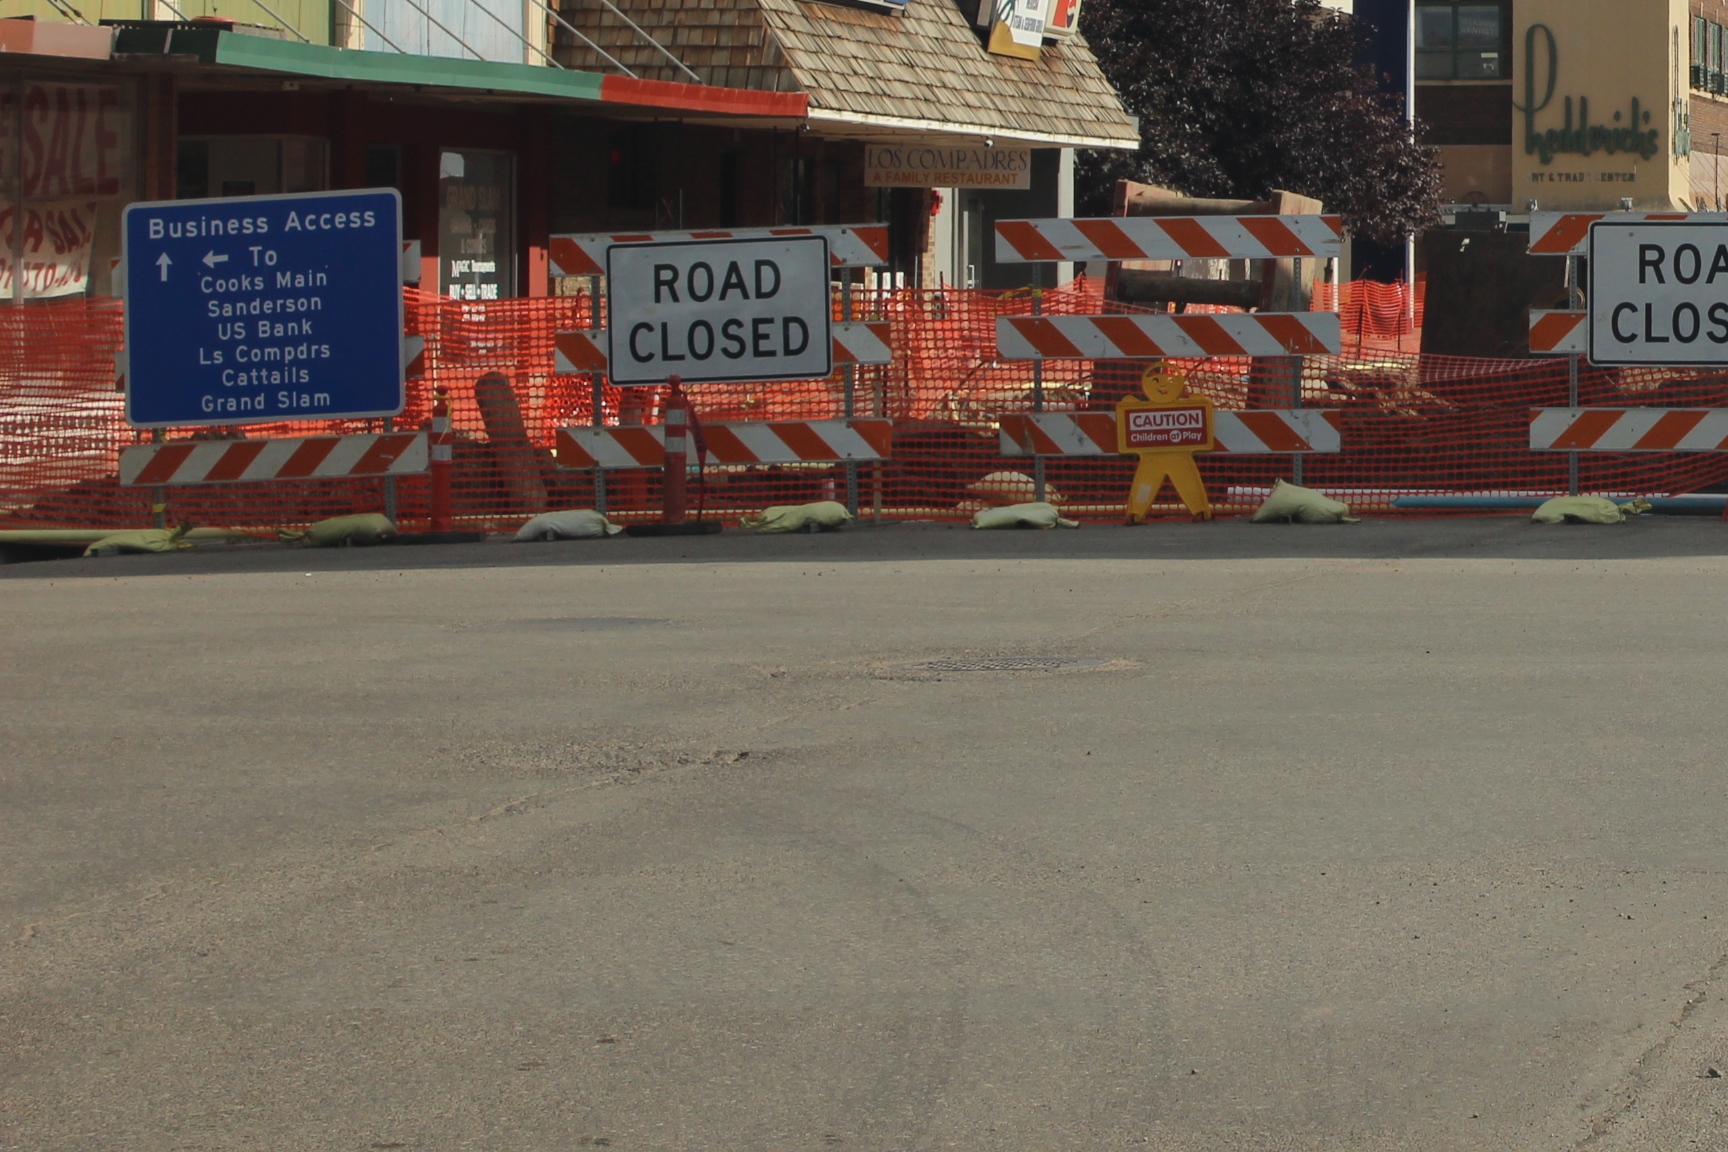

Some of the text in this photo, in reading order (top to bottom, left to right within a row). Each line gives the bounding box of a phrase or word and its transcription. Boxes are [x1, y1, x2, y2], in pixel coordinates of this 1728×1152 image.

[23, 85, 119, 194] SALE
[867, 148, 1028, 171] LOS COMPADRES
[873, 171, 1019, 185] A FAMILY RESTAURANT
[1558, 172, 1591, 183] TRAD
[1594, 172, 1636, 183] ENTER
[149, 211, 376, 239] Business Access
[249, 245, 278, 267] To
[201, 270, 328, 294] Cooks Main
[653, 259, 781, 304] ROAD
[208, 296, 322, 317] Sanderson
[218, 319, 313, 340] US Bank
[629, 315, 810, 364] CLOSED
[200, 343, 331, 365] Ls Compdrs
[222, 367, 310, 387] Cattails
[202, 391, 331, 413] Grand Slam
[1133, 413, 1200, 428] CAUTION
[1131, 431, 1202, 443] Children at Play
